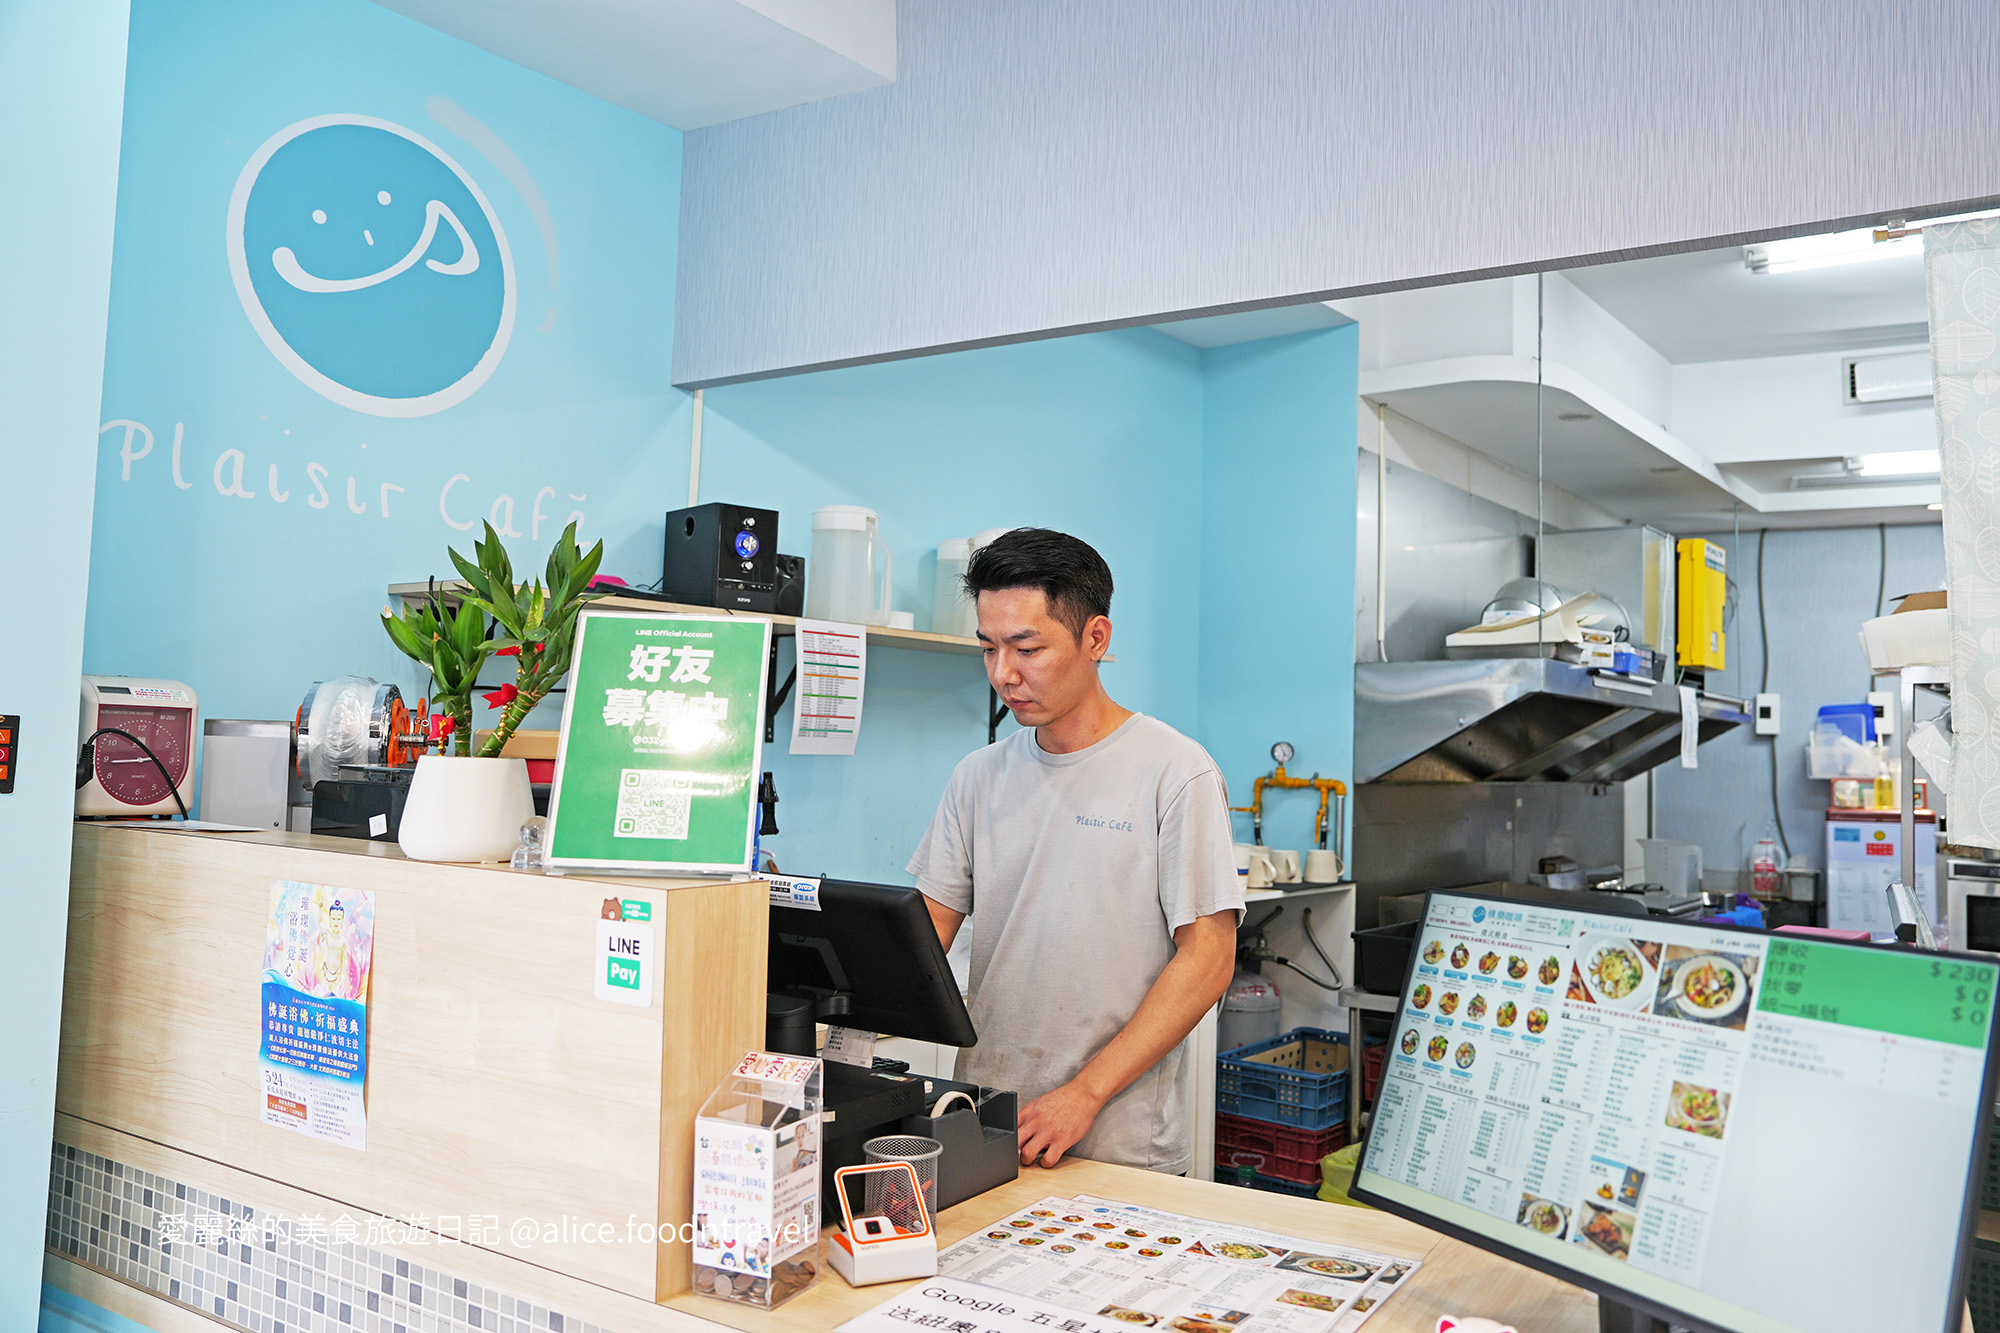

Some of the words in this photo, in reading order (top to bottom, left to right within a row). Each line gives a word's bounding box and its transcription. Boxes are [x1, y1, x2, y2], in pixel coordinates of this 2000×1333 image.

[99, 419, 406, 519] Plaisir
[653, 629, 681, 638] Official
[682, 631, 713, 639] Account
[627, 644, 715, 684] 好友
[602, 688, 729, 727] 募集中
[643, 799, 665, 808] LINE
[1076, 814, 1105, 828] Plaisir
[1109, 819, 1133, 832] Café
[609, 936, 640, 955] LINE
[610, 962, 638, 985] Pay
[1768, 960, 1807, 977] 付款
[1930, 961, 1942, 978] $
[1948, 964, 1992, 984] 230
[1764, 978, 1803, 996] 找零
[1954, 985, 1965, 1002] $
[1973, 988, 1989, 1005] 0
[1759, 997, 1840, 1023] 統一編號
[1951, 1006, 1963, 1023] $
[1970, 1009, 1986, 1026] 0
[881, 1305, 1004, 1333] 送紐奧
[922, 1287, 1016, 1316] Google
[1023, 1311, 1122, 1333] 五星
